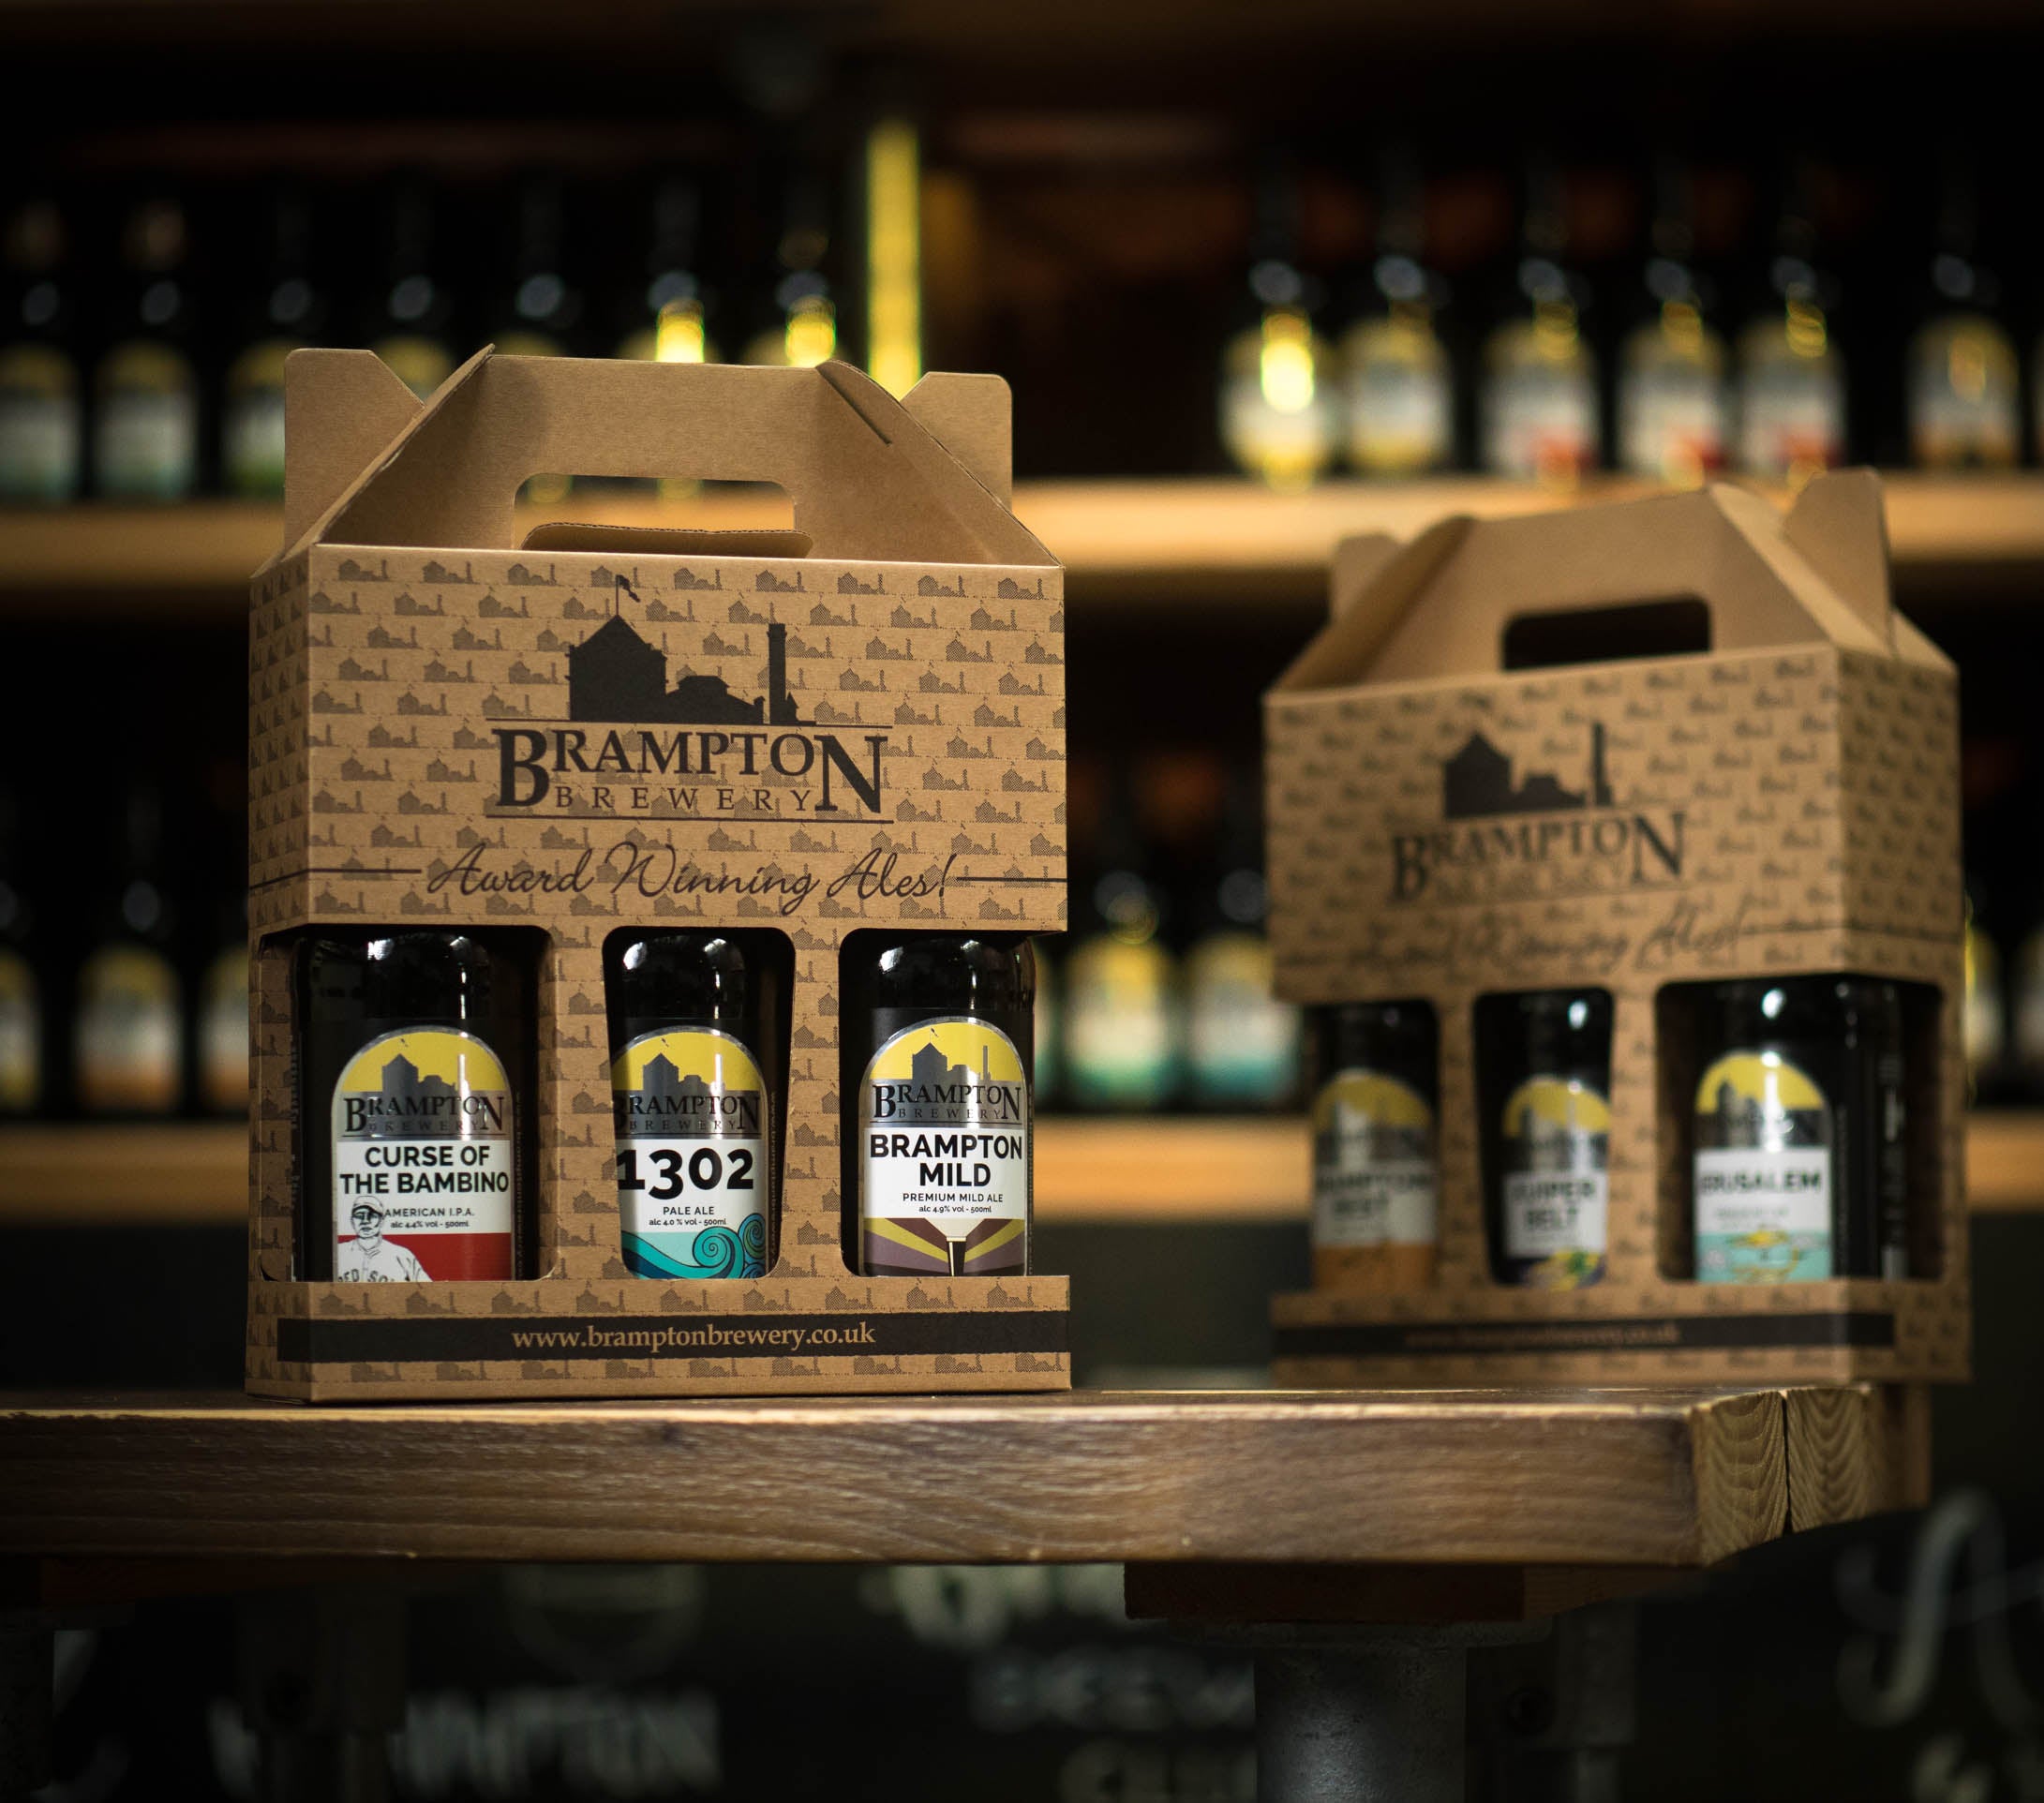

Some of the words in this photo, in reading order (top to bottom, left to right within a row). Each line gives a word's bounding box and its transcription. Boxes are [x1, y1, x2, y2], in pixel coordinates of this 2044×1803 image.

[491, 728, 888, 814] BRAMPTON
[555, 786, 811, 812] BREWERY
[427, 842, 595, 896] Award
[597, 842, 821, 916] Winning
[825, 846, 958, 900] Ales!
[343, 1095, 505, 1132] BRAMPTON
[873, 1084, 1022, 1121] BRAMPTON
[898, 1108, 1002, 1120] BREWERY
[629, 1119, 736, 1130] BREWERY
[365, 1145, 454, 1168] CURSE
[460, 1145, 490, 1167] OF
[870, 1133, 1022, 1160] BRAMPTON
[339, 1173, 390, 1195] THE
[396, 1171, 509, 1194] BAMBINO
[616, 1146, 753, 1200] 1302
[919, 1162, 992, 1187] MILD
[903, 1193, 955, 1202] PREMIUM
[959, 1193, 984, 1202] MILD
[987, 1193, 1004, 1203] ALE
[932, 1205, 950, 1214] 4.9%
[970, 1205, 992, 1214] 500ml
[384, 1207, 445, 1217] AMERICAN
[449, 1207, 475, 1216] I.P.A.
[649, 1217, 662, 1226] alc
[663, 1218, 675, 1227] 4.0
[684, 1217, 697, 1226] vol
[704, 1218, 726, 1227] 500ml
[663, 1206, 691, 1215] PALE
[694, 1206, 715, 1215] ALE
[390, 1220, 404, 1229] alc
[405, 1220, 424, 1229] 4.4%
[445, 1220, 470, 1229] 500ml
[511, 1321, 876, 1353] www.bramptonbrewery.co.uk
